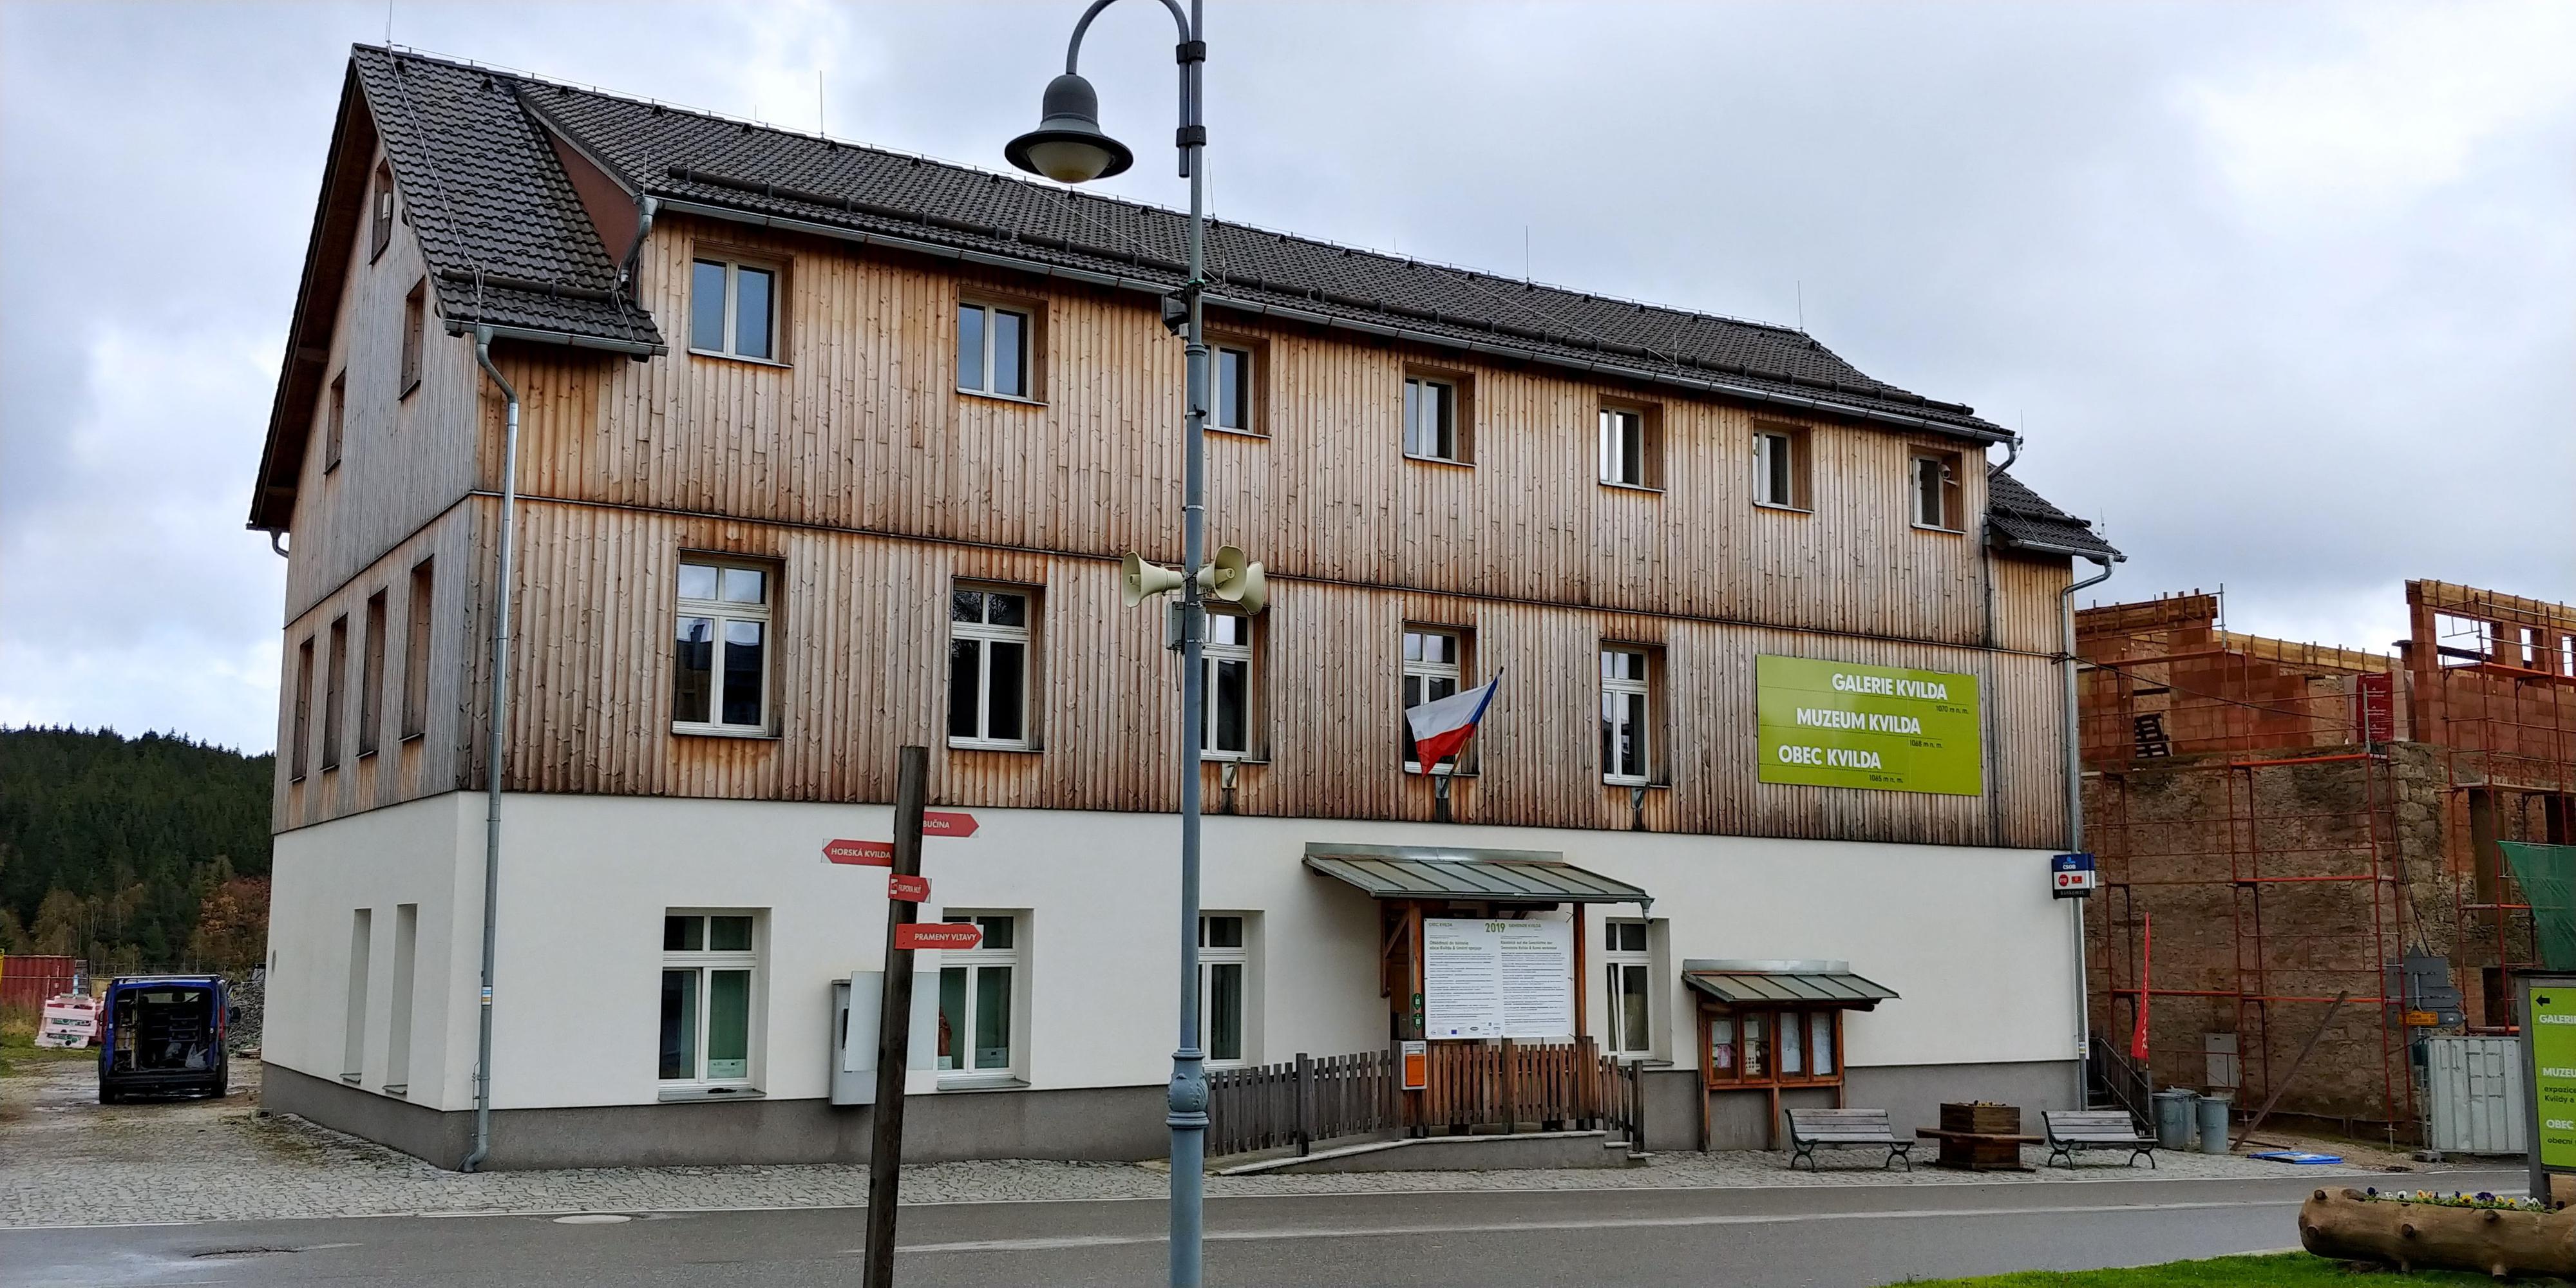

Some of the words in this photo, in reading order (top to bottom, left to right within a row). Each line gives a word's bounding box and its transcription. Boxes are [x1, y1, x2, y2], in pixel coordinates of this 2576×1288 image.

[1832, 674, 1893, 696] GALERIE
[1896, 679, 1948, 701] KVILDA
[1796, 708, 1866, 730] MUZEUM
[1869, 714, 1922, 735] KVILDA
[1778, 744, 1823, 765] OBEC
[1827, 748, 1882, 770] KVILDA
[923, 819, 950, 829] BUČINA
[831, 848, 863, 857] HORSKÁ
[864, 850, 891, 859] KVILDA
[1485, 922, 1506, 933] 2019
[2544, 1095, 2568, 1103] Kvildy
[2546, 1119, 2574, 1130] OBEC
